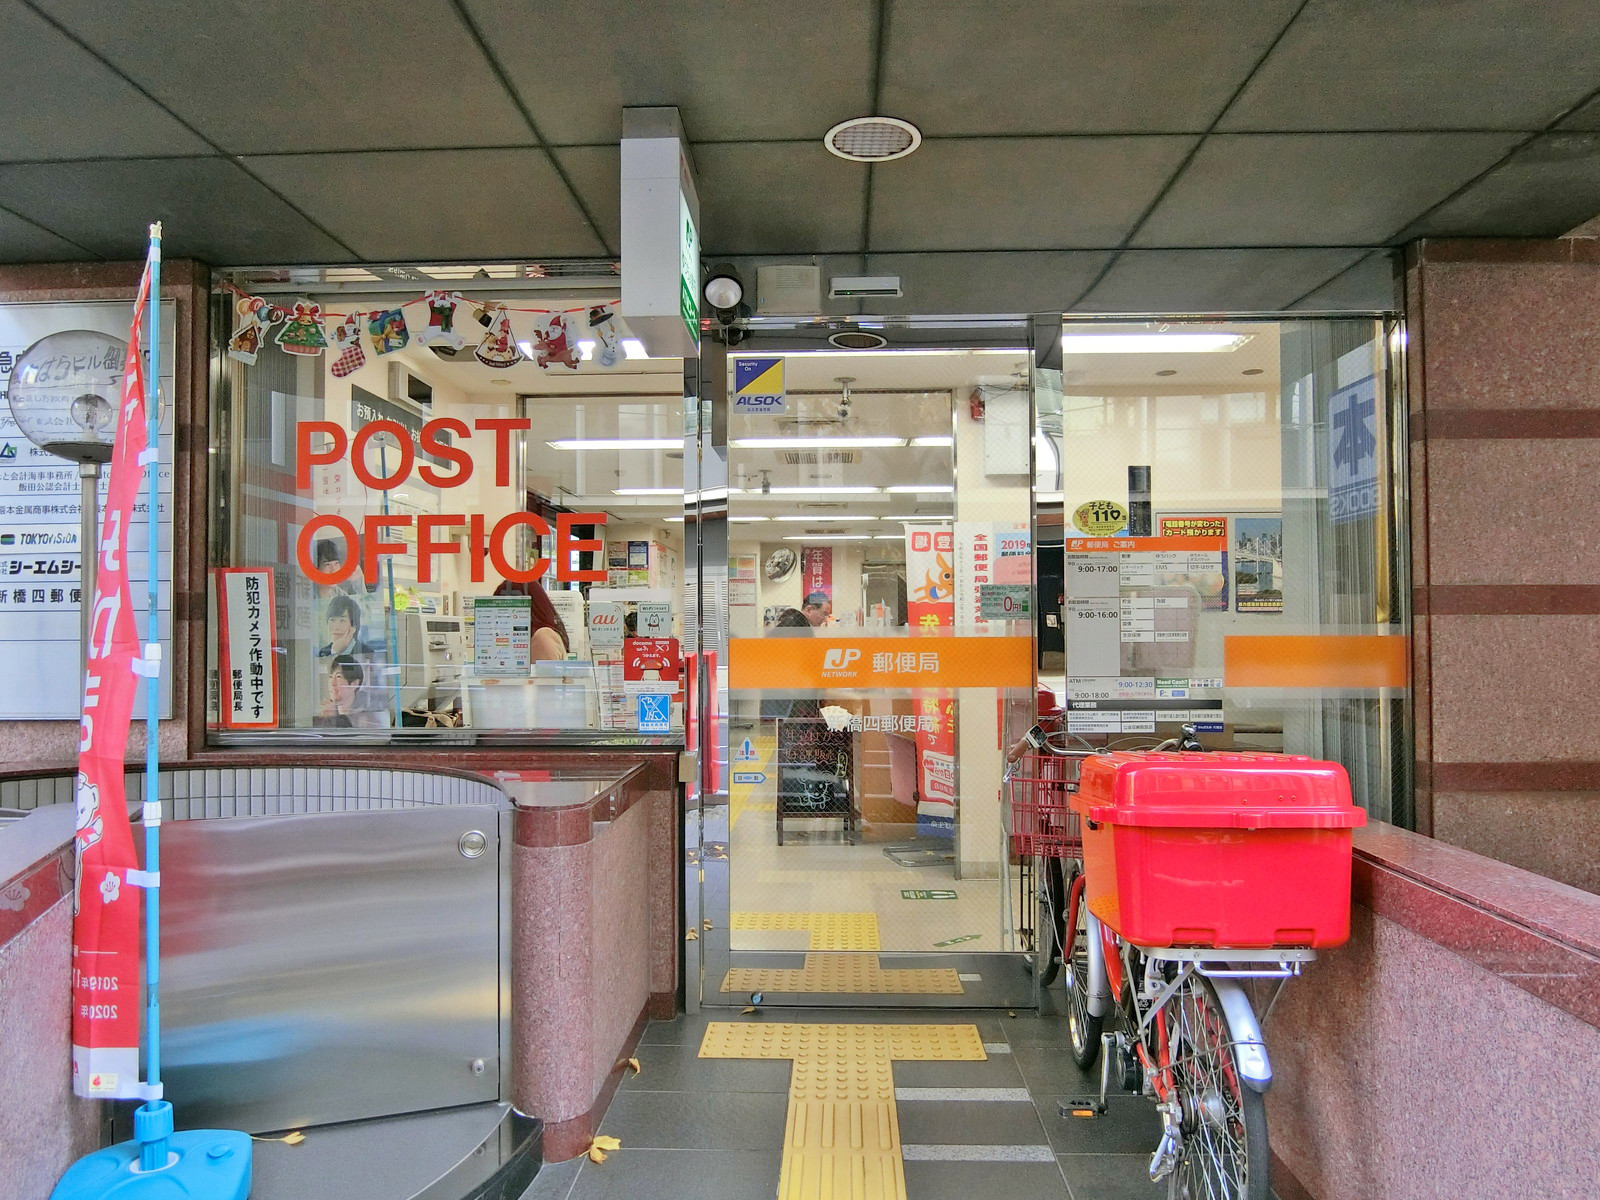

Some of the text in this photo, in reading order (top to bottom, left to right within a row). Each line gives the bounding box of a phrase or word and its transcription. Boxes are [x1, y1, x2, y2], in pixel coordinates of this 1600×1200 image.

[735, 396, 783, 406] ALSOK
[295, 417, 532, 491] POST
[1089, 501, 1113, 510] 子ども
[296, 511, 608, 585] OFFICE
[1113, 541, 1136, 549] ご案内
[1078, 565, 1118, 573] 9:00-17:00
[592, 614, 619, 625] au
[1078, 611, 1118, 619] 9:00-16:00
[245, 576, 264, 719] 防犯カメラ作動中です
[823, 648, 861, 670] JP
[872, 652, 940, 674] 郵便局
[233, 669, 243, 712] 郵便局長
